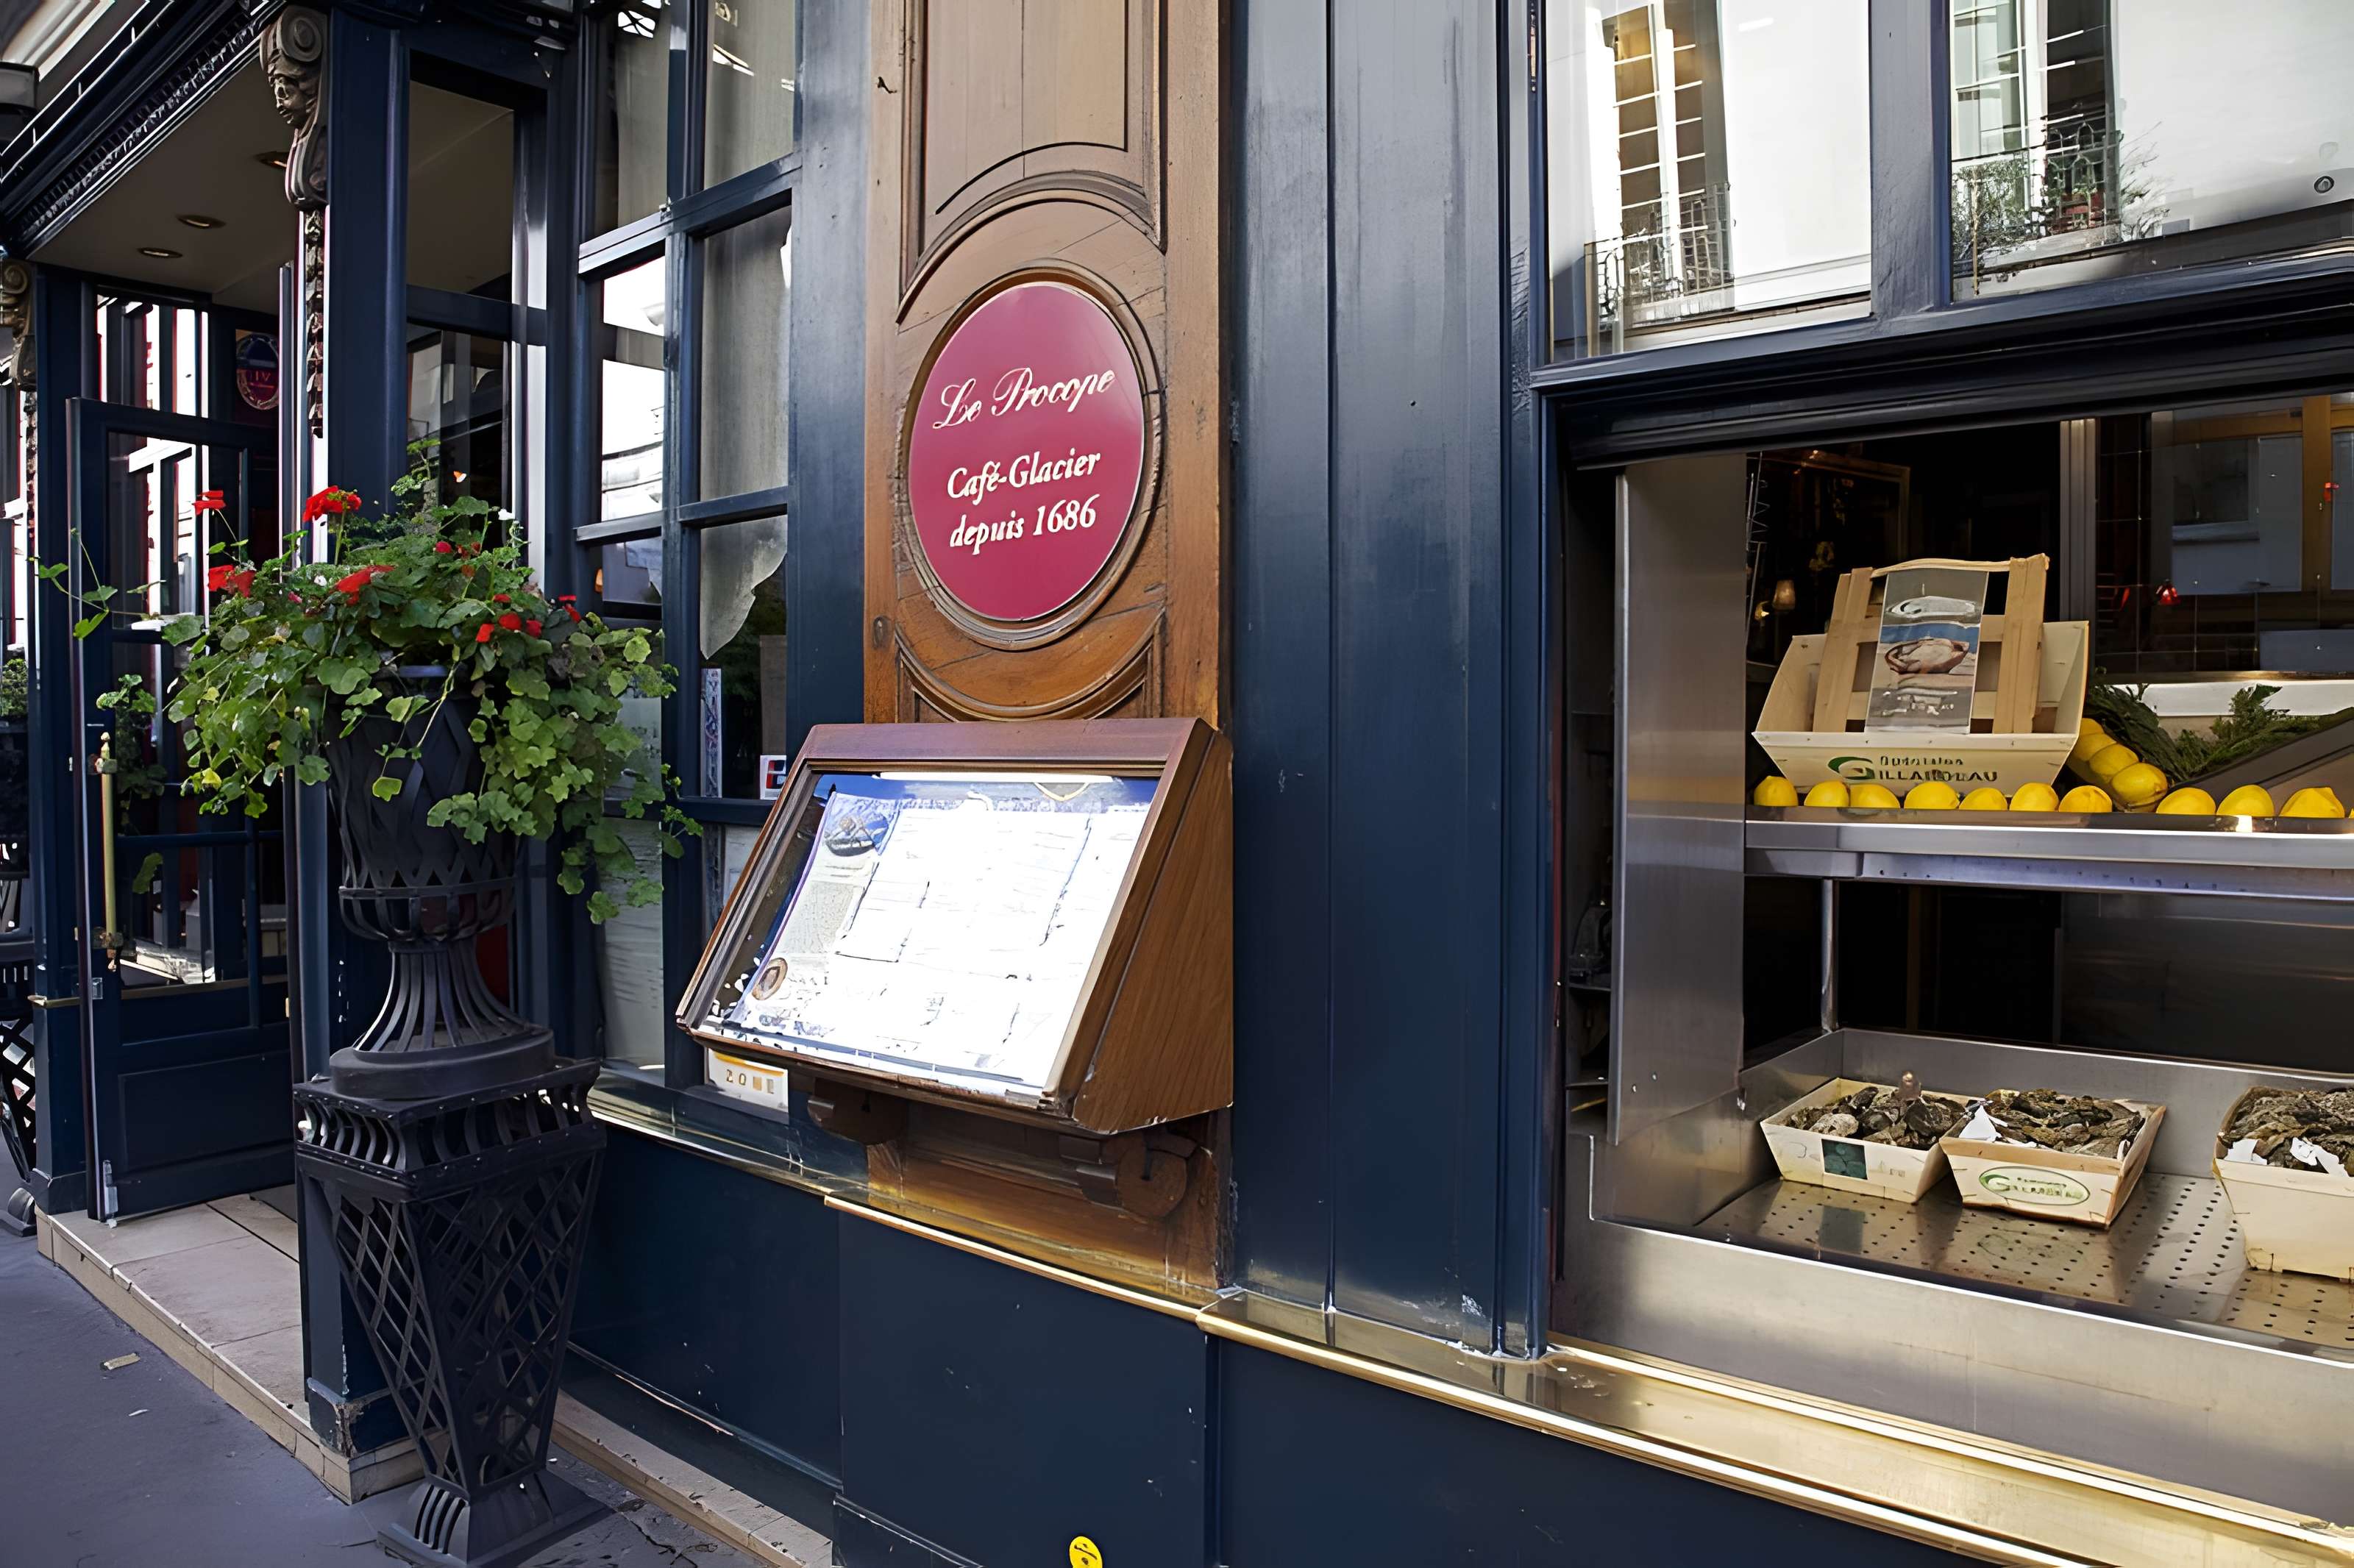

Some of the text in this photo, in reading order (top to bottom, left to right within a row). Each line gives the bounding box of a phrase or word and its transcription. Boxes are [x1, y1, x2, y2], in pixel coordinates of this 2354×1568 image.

[933, 367, 1115, 429] Le Procope
[947, 447, 1101, 505] Café-Glacier
[949, 493, 1100, 555] depuis 1686
